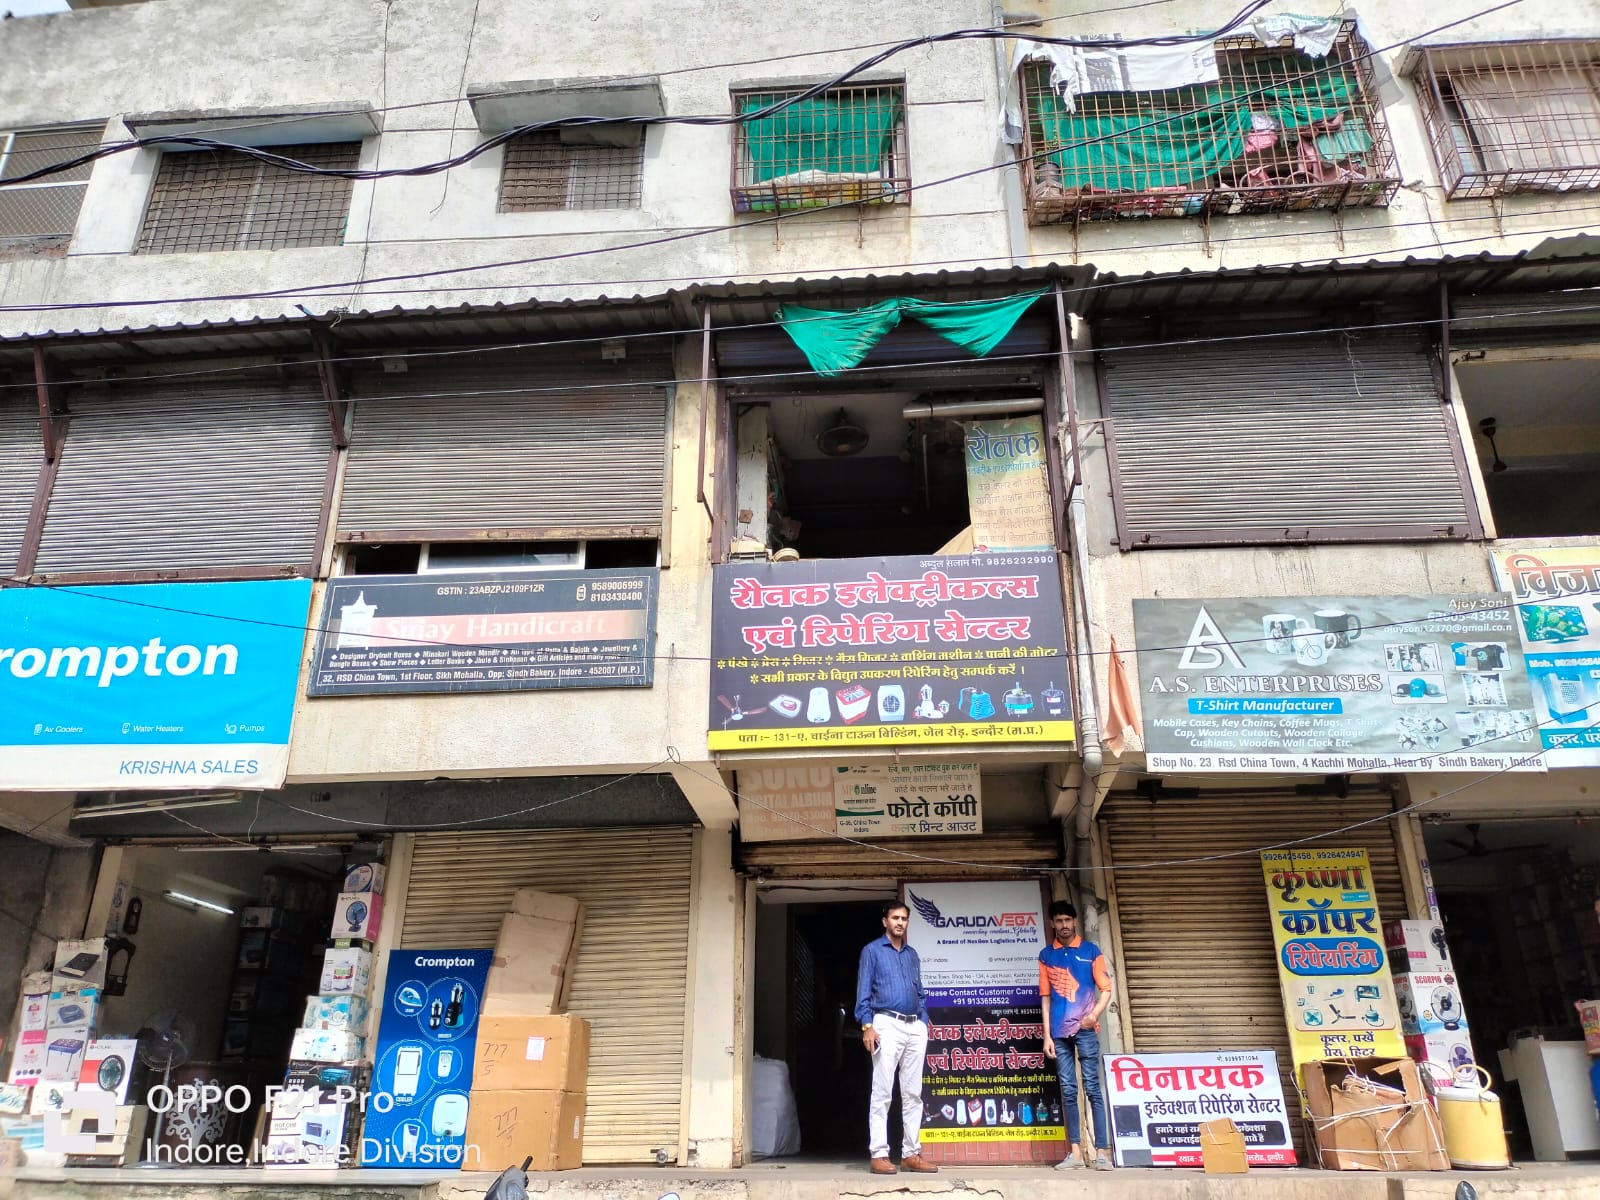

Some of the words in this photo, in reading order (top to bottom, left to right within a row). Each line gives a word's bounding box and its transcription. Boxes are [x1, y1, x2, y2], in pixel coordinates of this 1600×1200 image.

[920, 560, 944, 569] अब्दुल
[947, 559, 969, 567] सलाम
[986, 556, 1054, 565] 9826232990
[437, 587, 463, 595] GSTIN
[731, 579, 830, 608] रौनक
[834, 570, 1038, 608] इलेक्ट्रीकल्स
[1449, 599, 1476, 609] Ajay
[1480, 598, 1507, 608] Soni
[387, 620, 455, 641] Sujay
[466, 614, 606, 637] Handicraft
[743, 617, 796, 654] एवं
[802, 613, 929, 645] रिपेरिंग
[935, 610, 1031, 641] सेन्टर
[901, 650, 936, 661] वाशिंग
[938, 648, 972, 660] मशीन
[986, 647, 1010, 659] पानी
[1013, 646, 1027, 658] की
[354, 673, 375, 681] China
[401, 672, 411, 680] 1st
[436, 671, 451, 679] Sikh
[507, 669, 528, 677] Sindh
[559, 667, 582, 676] Indore
[589, 666, 615, 674] 452007
[761, 670, 784, 683] सभी
[787, 671, 815, 682] प्रकार
[817, 670, 828, 681] के
[831, 669, 857, 683] विद्युत
[860, 668, 900, 680] उपकरण
[903, 666, 940, 678] रिपेरिंग
[943, 665, 958, 680] हेतु
[998, 663, 1016, 675] करें
[1149, 676, 1196, 693] A.S.
[1203, 674, 1383, 694] ENTERPRISES
[1196, 700, 1239, 711] T-Shirt
[1243, 700, 1334, 712] Manufacturer
[240, 724, 264, 732] Pumps
[1153, 719, 1186, 727] Mobile
[1189, 719, 1219, 728] Cases,
[1222, 719, 1239, 728] Key
[1242, 719, 1276, 728] Chains,
[1280, 719, 1310, 728] Coffee
[924, 727, 943, 736] जेल
[971, 725, 1004, 736] इन्दौर
[1175, 729, 1195, 738] Cap,
[1199, 729, 1238, 737] Wooden
[1241, 729, 1281, 738] Cutouts,
[1284, 729, 1324, 737] Wooden
[1190, 739, 1236, 748] Cushions,
[1240, 739, 1279, 748] Wooden
[1283, 739, 1304, 747] Wall
[1308, 739, 1332, 747] Clock
[1336, 739, 1352, 747] Etc.
[120, 761, 196, 774] KRISHNA
[201, 760, 258, 774] SALES
[1153, 758, 1176, 769] Shop
[1180, 758, 1196, 767] No.
[1219, 758, 1236, 767] Rsd
[1240, 758, 1267, 767] China
[1270, 758, 1299, 768] Town,
[1302, 758, 1308, 767] 4
[1311, 758, 1344, 768] Kachhi
[1347, 758, 1390, 768] Mohalla,
[1394, 758, 1417, 767] Near
[1421, 757, 1432, 769] By
[1439, 757, 1467, 767] Sindh
[1471, 757, 1507, 768] Bakery,
[1511, 757, 1542, 767] Indore
[887, 796, 930, 818] फोटो
[933, 794, 977, 817] कॉपी
[920, 820, 943, 833] प्रिन्ट
[947, 822, 976, 832] आउट
[1267, 866, 1367, 903] कृष्णा
[1279, 898, 1377, 935] कॉपर
[1286, 941, 1379, 969] रिपेयरिंग
[414, 956, 475, 968] Crompton
[949, 988, 977, 996] Contact
[1320, 1035, 1350, 1048] कूलर,
[1350, 1047, 1375, 1057] हिटर
[927, 1048, 949, 1074] एवं
[951, 1047, 1005, 1070] रिपेरिंग
[1006, 1047, 1045, 1069] सेन्टर
[1111, 1057, 1264, 1091] विनायक
[1144, 1095, 1196, 1118] इन्डेक्शन
[1199, 1093, 1245, 1115] रिपेरिंग
[1247, 1093, 1281, 1113] सेन्टर
